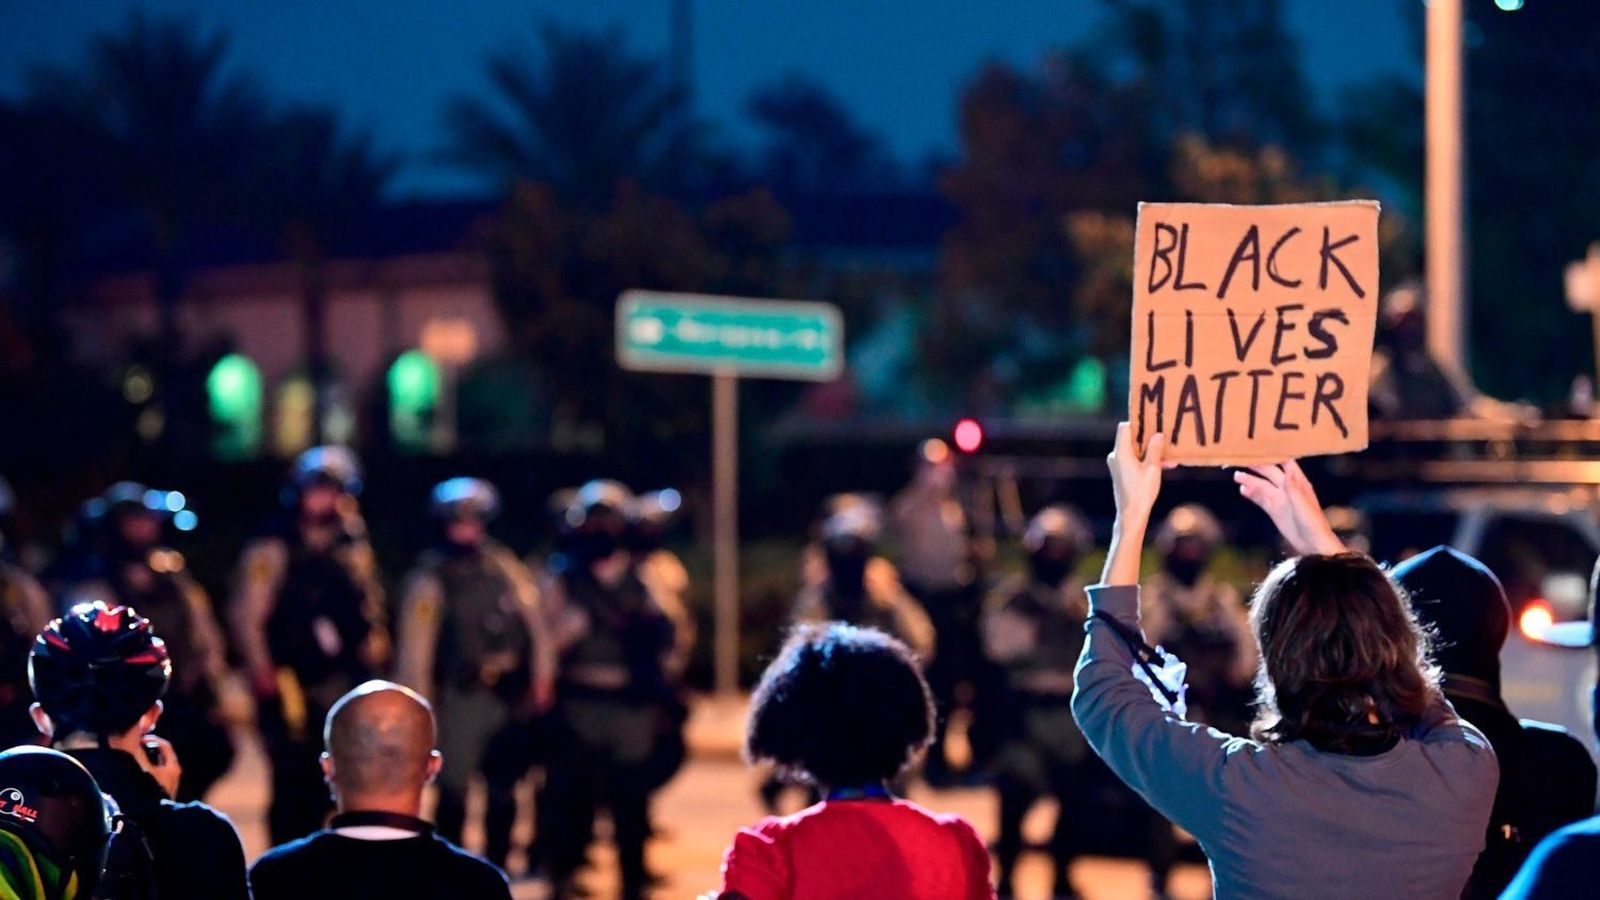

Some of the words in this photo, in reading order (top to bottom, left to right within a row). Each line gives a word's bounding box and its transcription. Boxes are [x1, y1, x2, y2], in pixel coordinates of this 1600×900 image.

[1148, 222, 1366, 299] BLACK
[1146, 304, 1350, 372] LIVES
[1135, 369, 1349, 449] MATTER
